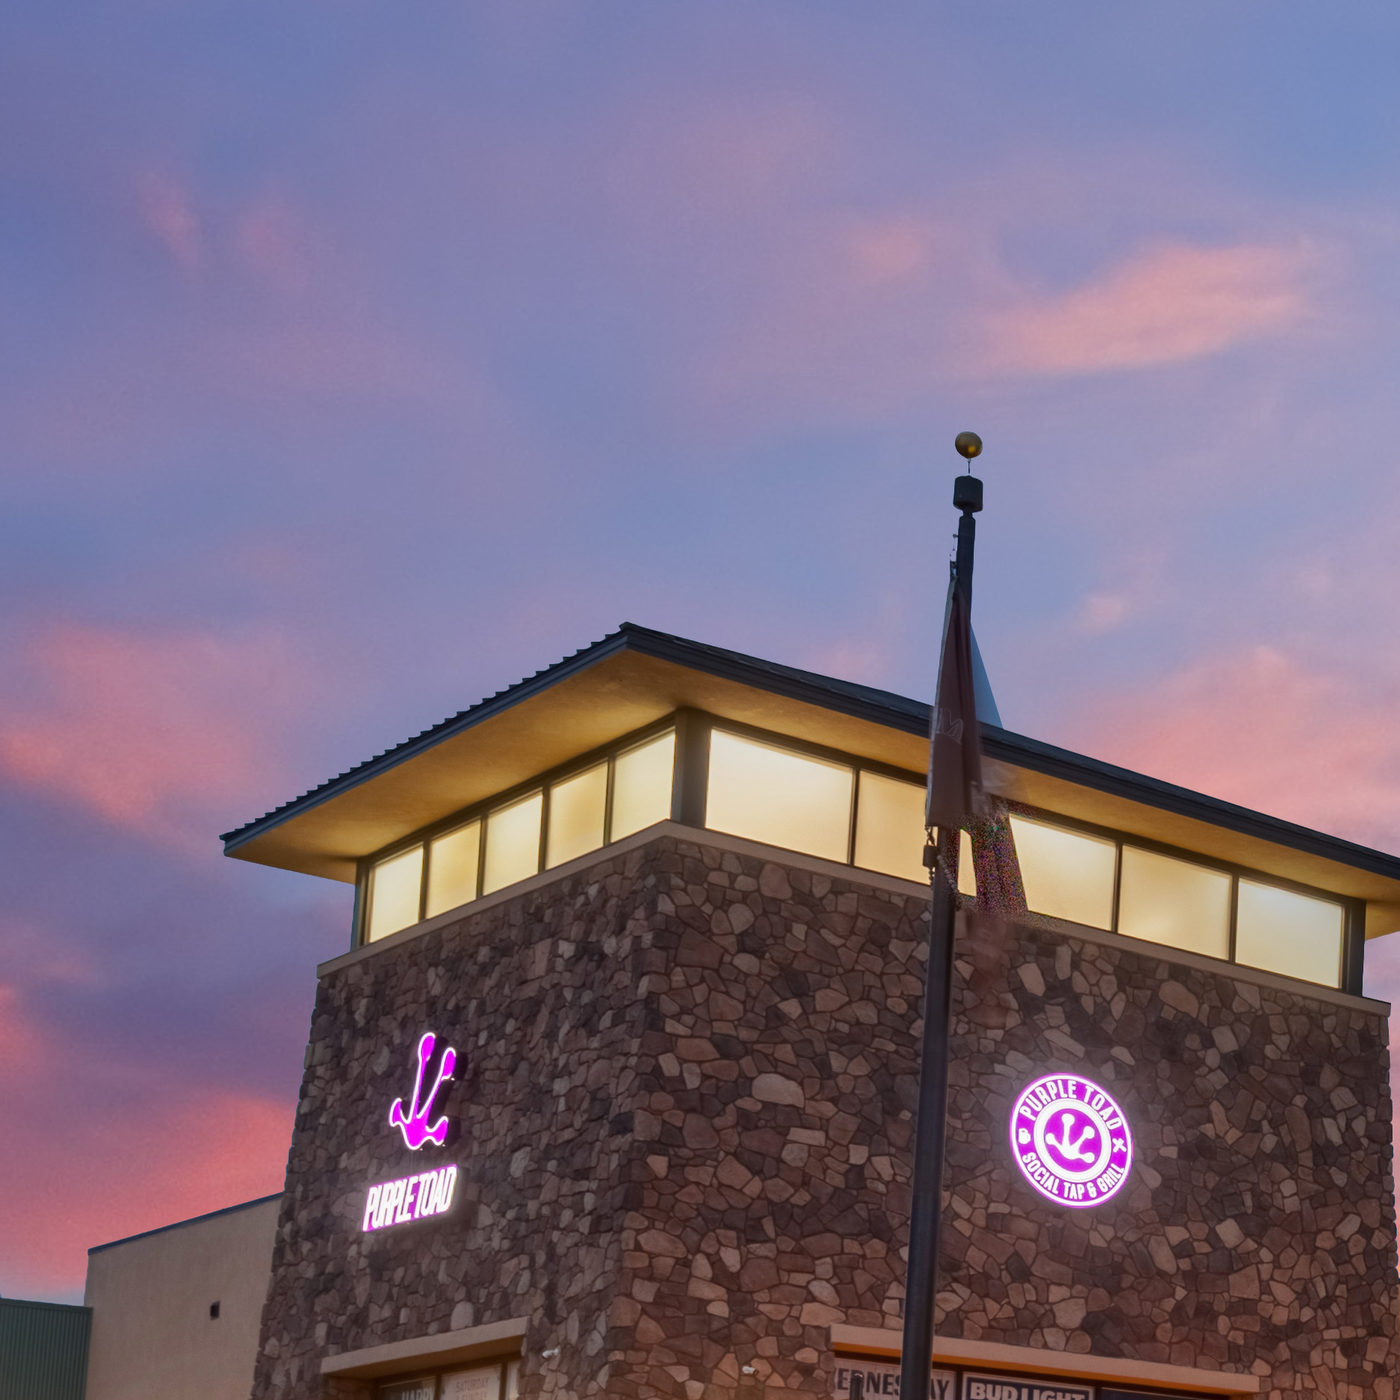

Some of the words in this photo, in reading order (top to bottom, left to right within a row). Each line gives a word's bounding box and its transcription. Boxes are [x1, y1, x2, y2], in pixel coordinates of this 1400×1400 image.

[1019, 1079, 1077, 1121] PURPLE
[1083, 1085, 1122, 1130] TOAD
[362, 1175, 419, 1232] PURPLE
[414, 1166, 457, 1218] TOAD
[1022, 1152, 1059, 1195] SOCIAL
[1063, 1182, 1085, 1200] TAP
[1097, 1163, 1124, 1193] GRILL
